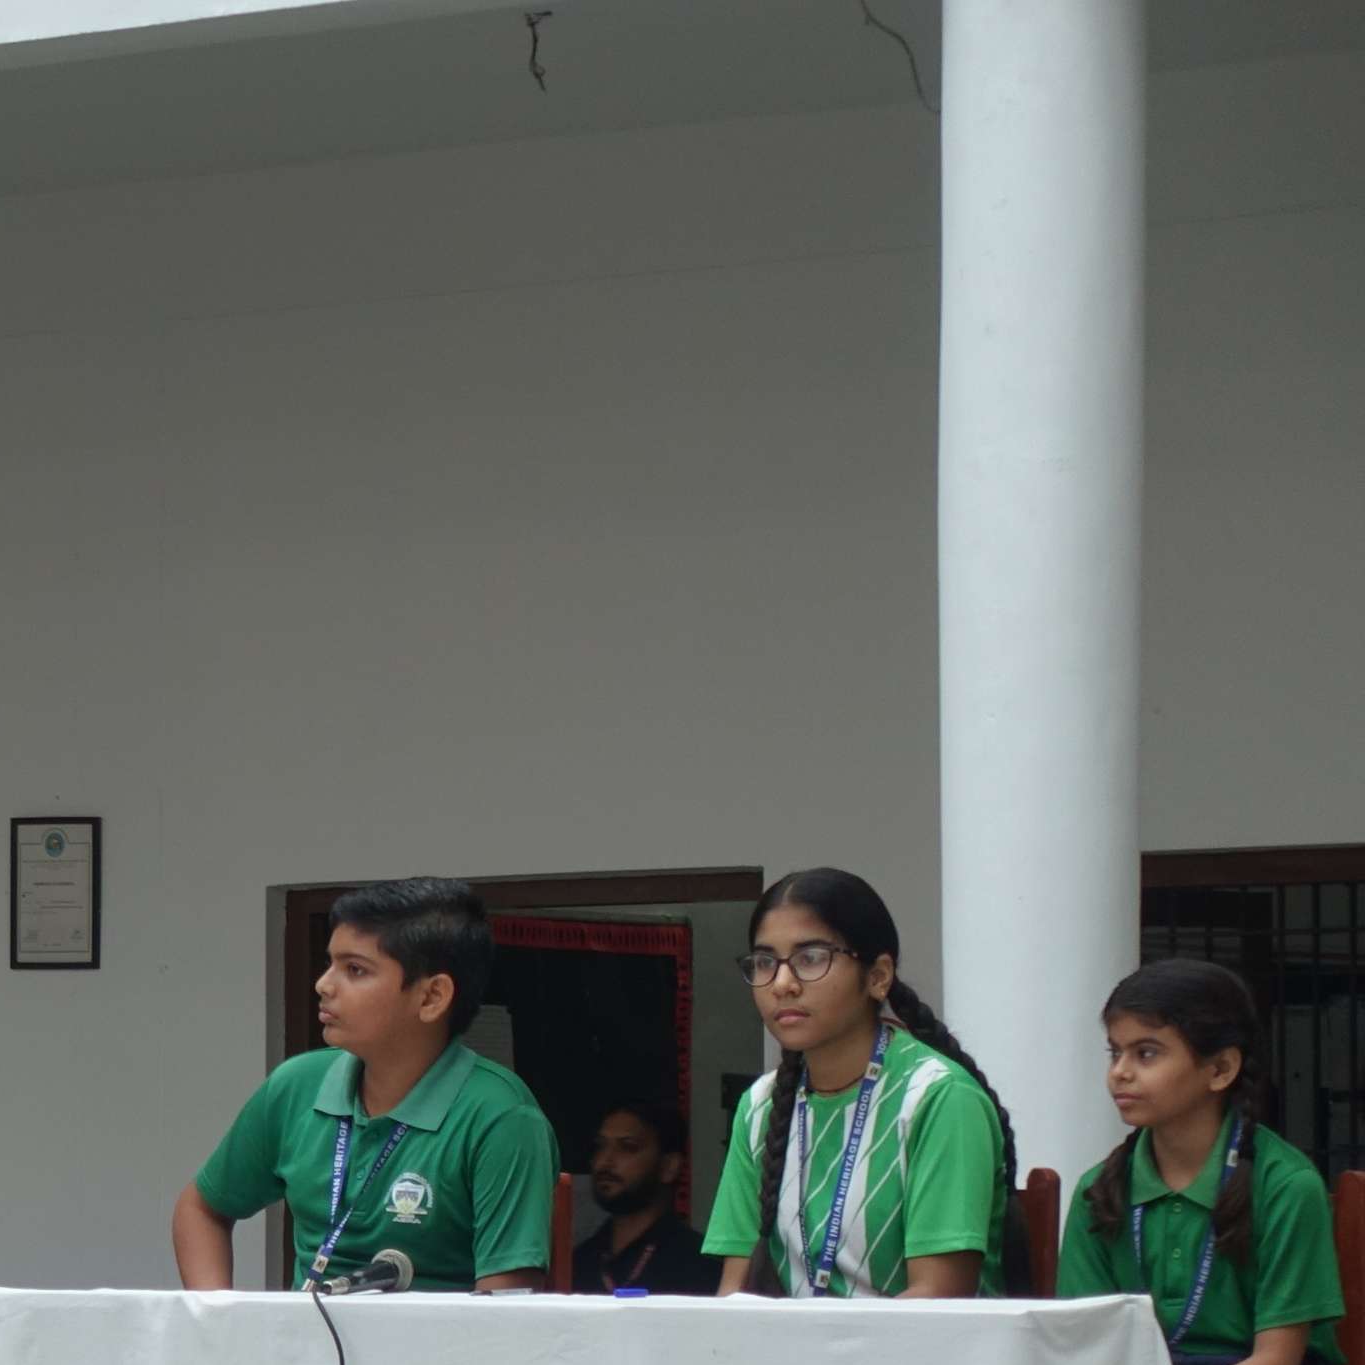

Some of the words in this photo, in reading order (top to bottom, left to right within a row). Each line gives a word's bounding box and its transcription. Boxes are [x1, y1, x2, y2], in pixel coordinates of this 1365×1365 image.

[333, 1121, 349, 1176] HERITAGE
[824, 1238, 836, 1263] THE
[830, 1198, 844, 1239] INDIAN
[839, 1138, 859, 1197] HERITAGE
[853, 1089, 871, 1136] SCHOOL
